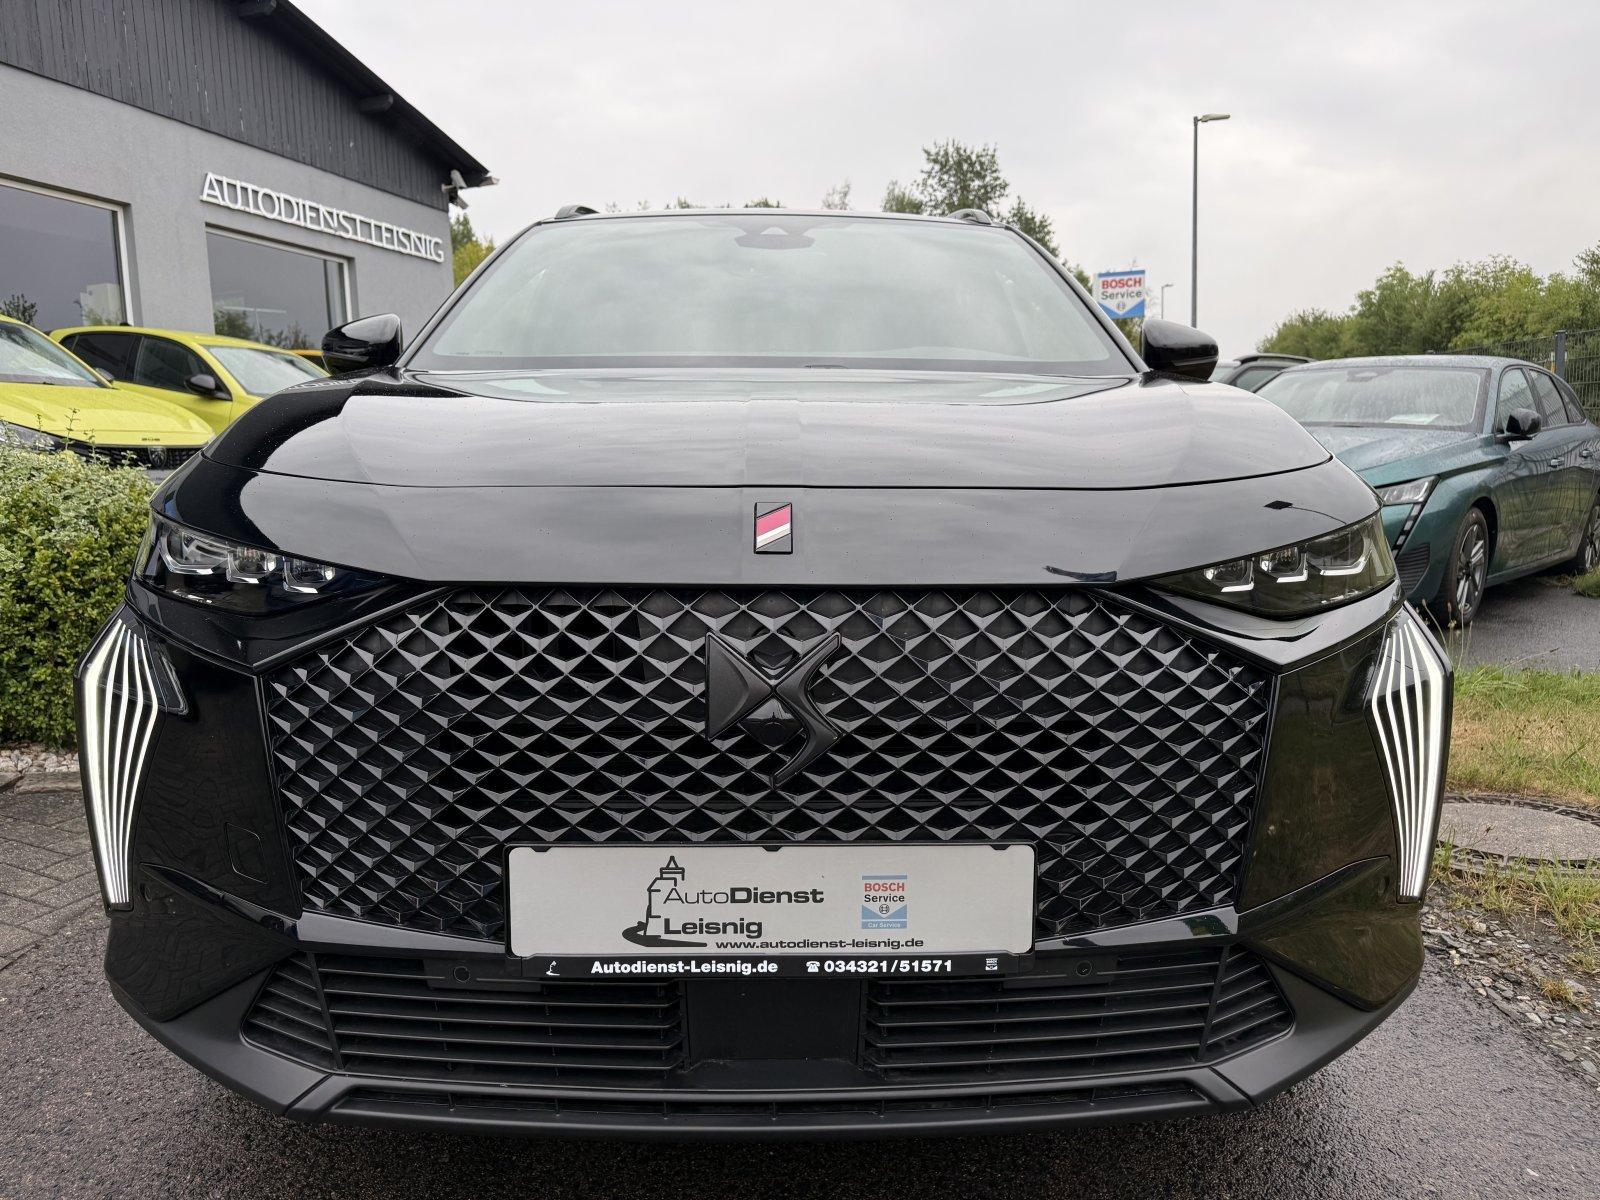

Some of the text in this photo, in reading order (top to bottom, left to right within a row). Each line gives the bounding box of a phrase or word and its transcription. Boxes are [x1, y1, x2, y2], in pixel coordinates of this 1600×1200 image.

[1101, 277, 1142, 289] BOSCH
[1101, 290, 1142, 300] Service
[864, 882, 905, 892] BOSCH
[663, 887, 824, 904] AutoDienst
[864, 893, 905, 903] Service
[664, 918, 763, 939] Leisnig
[715, 938, 924, 949] www.autodienst-leisnig.de
[590, 959, 952, 975] Autodienst-Leisnig.de 034321/51571
